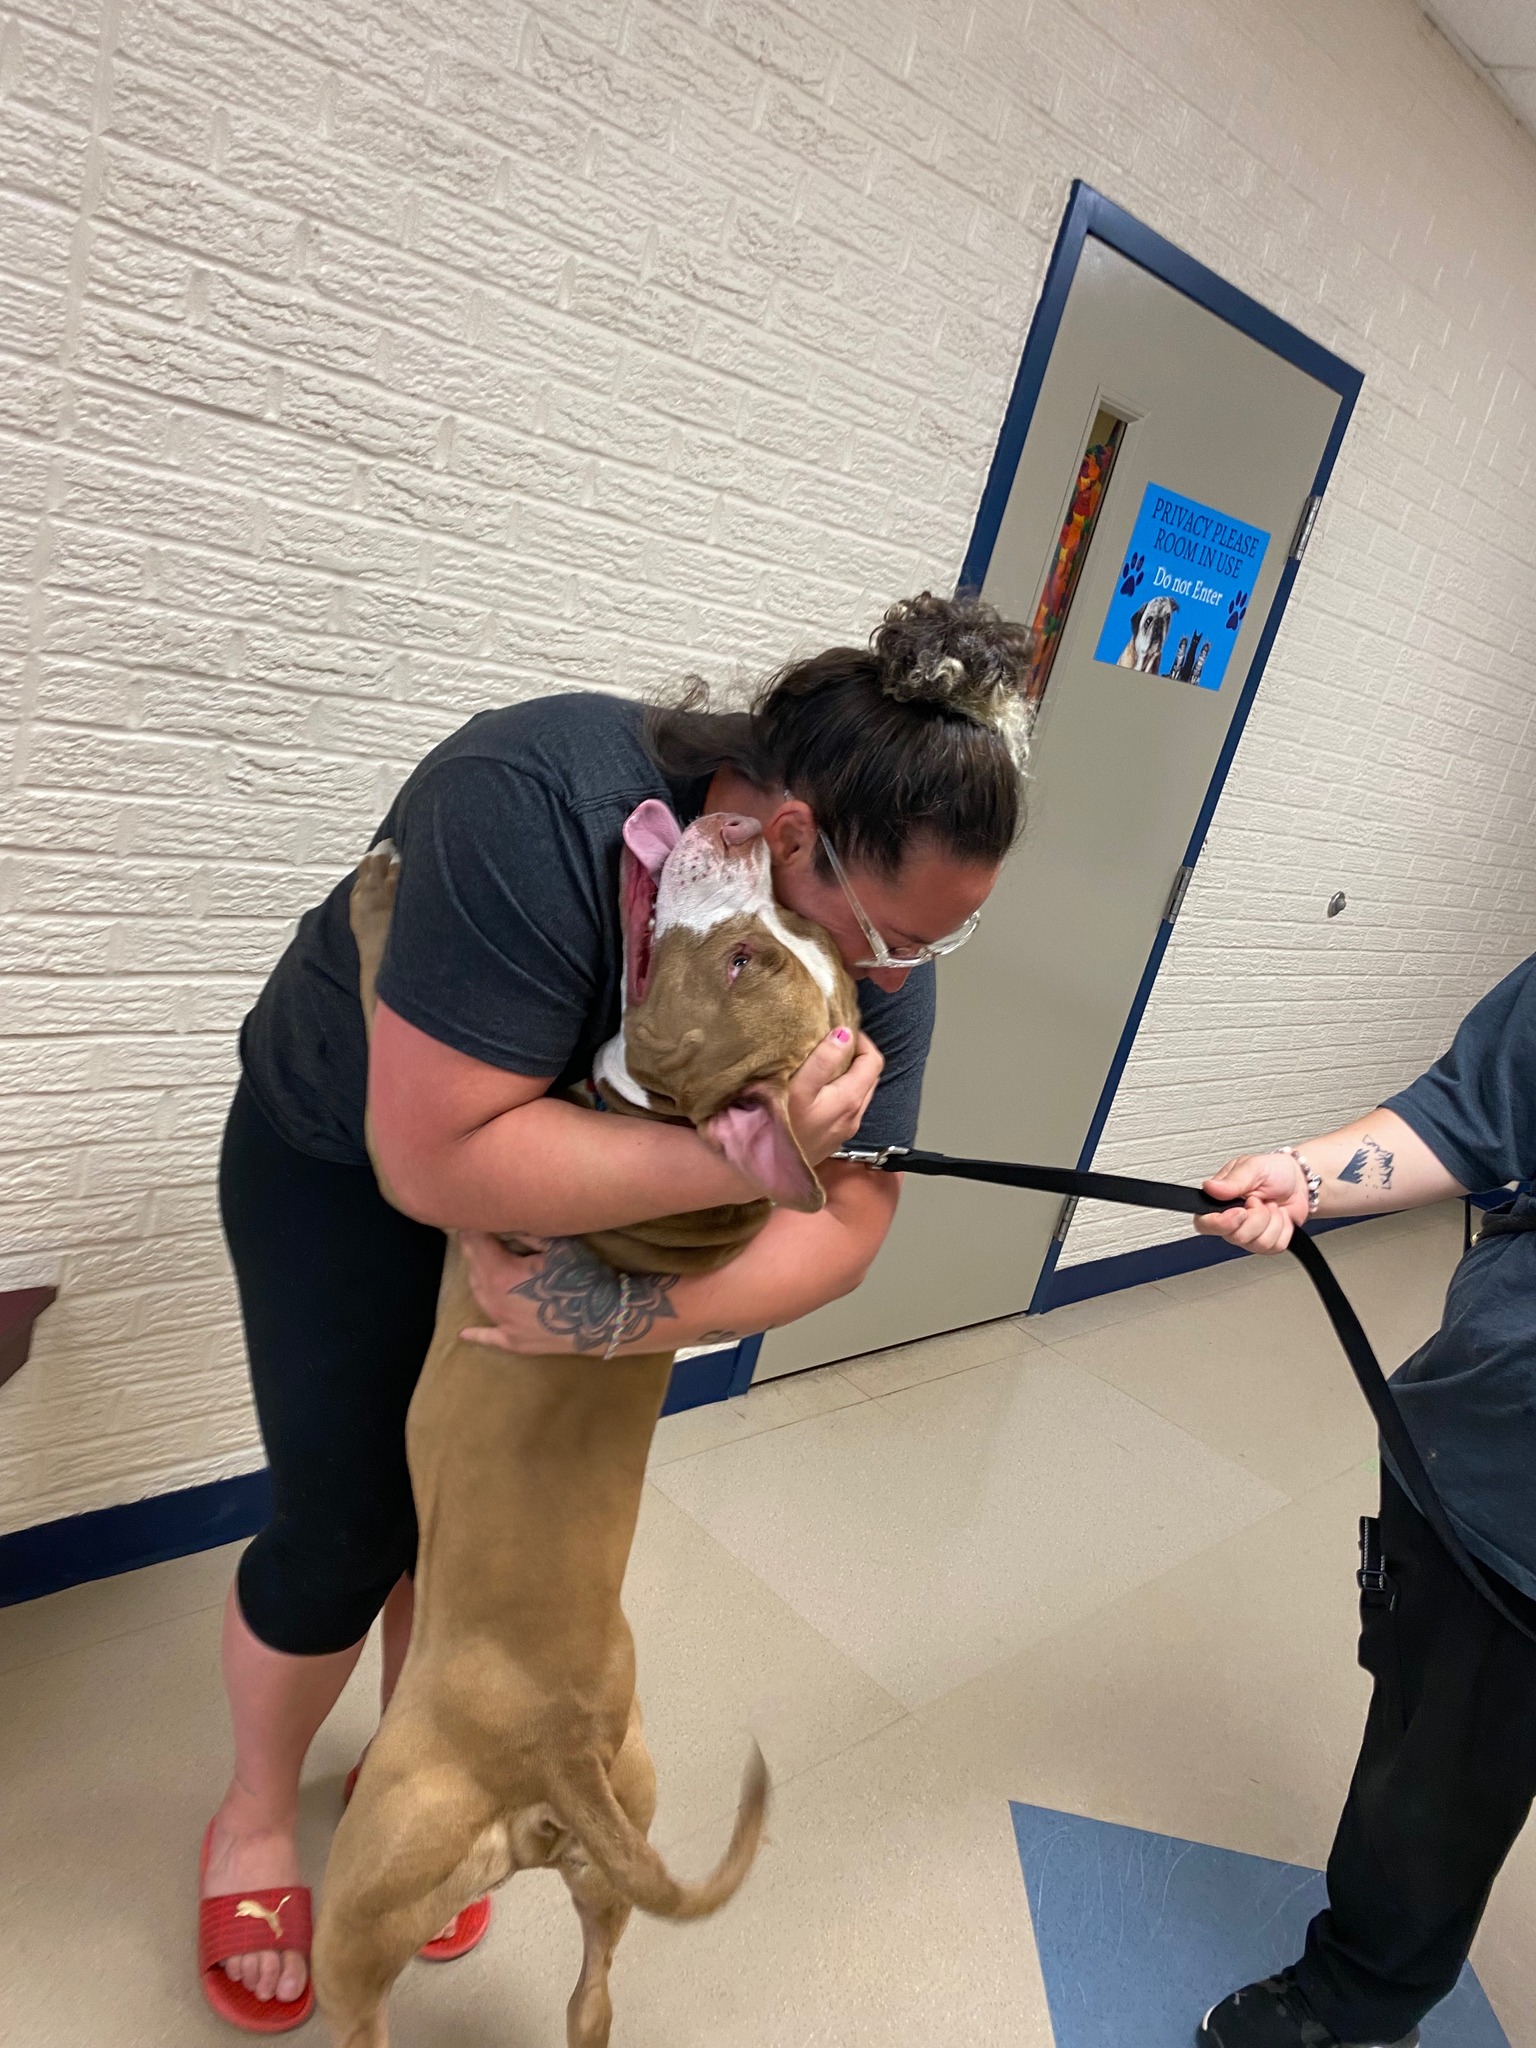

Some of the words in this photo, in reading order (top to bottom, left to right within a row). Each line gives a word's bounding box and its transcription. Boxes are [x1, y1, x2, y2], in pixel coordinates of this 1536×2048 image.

[1152, 497, 1214, 539] PRIVACY
[1211, 522, 1260, 559] PLEASE
[1153, 527, 1199, 563] ROOM
[1197, 545, 1217, 569] IN
[1216, 553, 1243, 579] USE
[1153, 566, 1172, 589] Do
[1171, 577, 1193, 597] not
[1191, 580, 1223, 606] Enter
